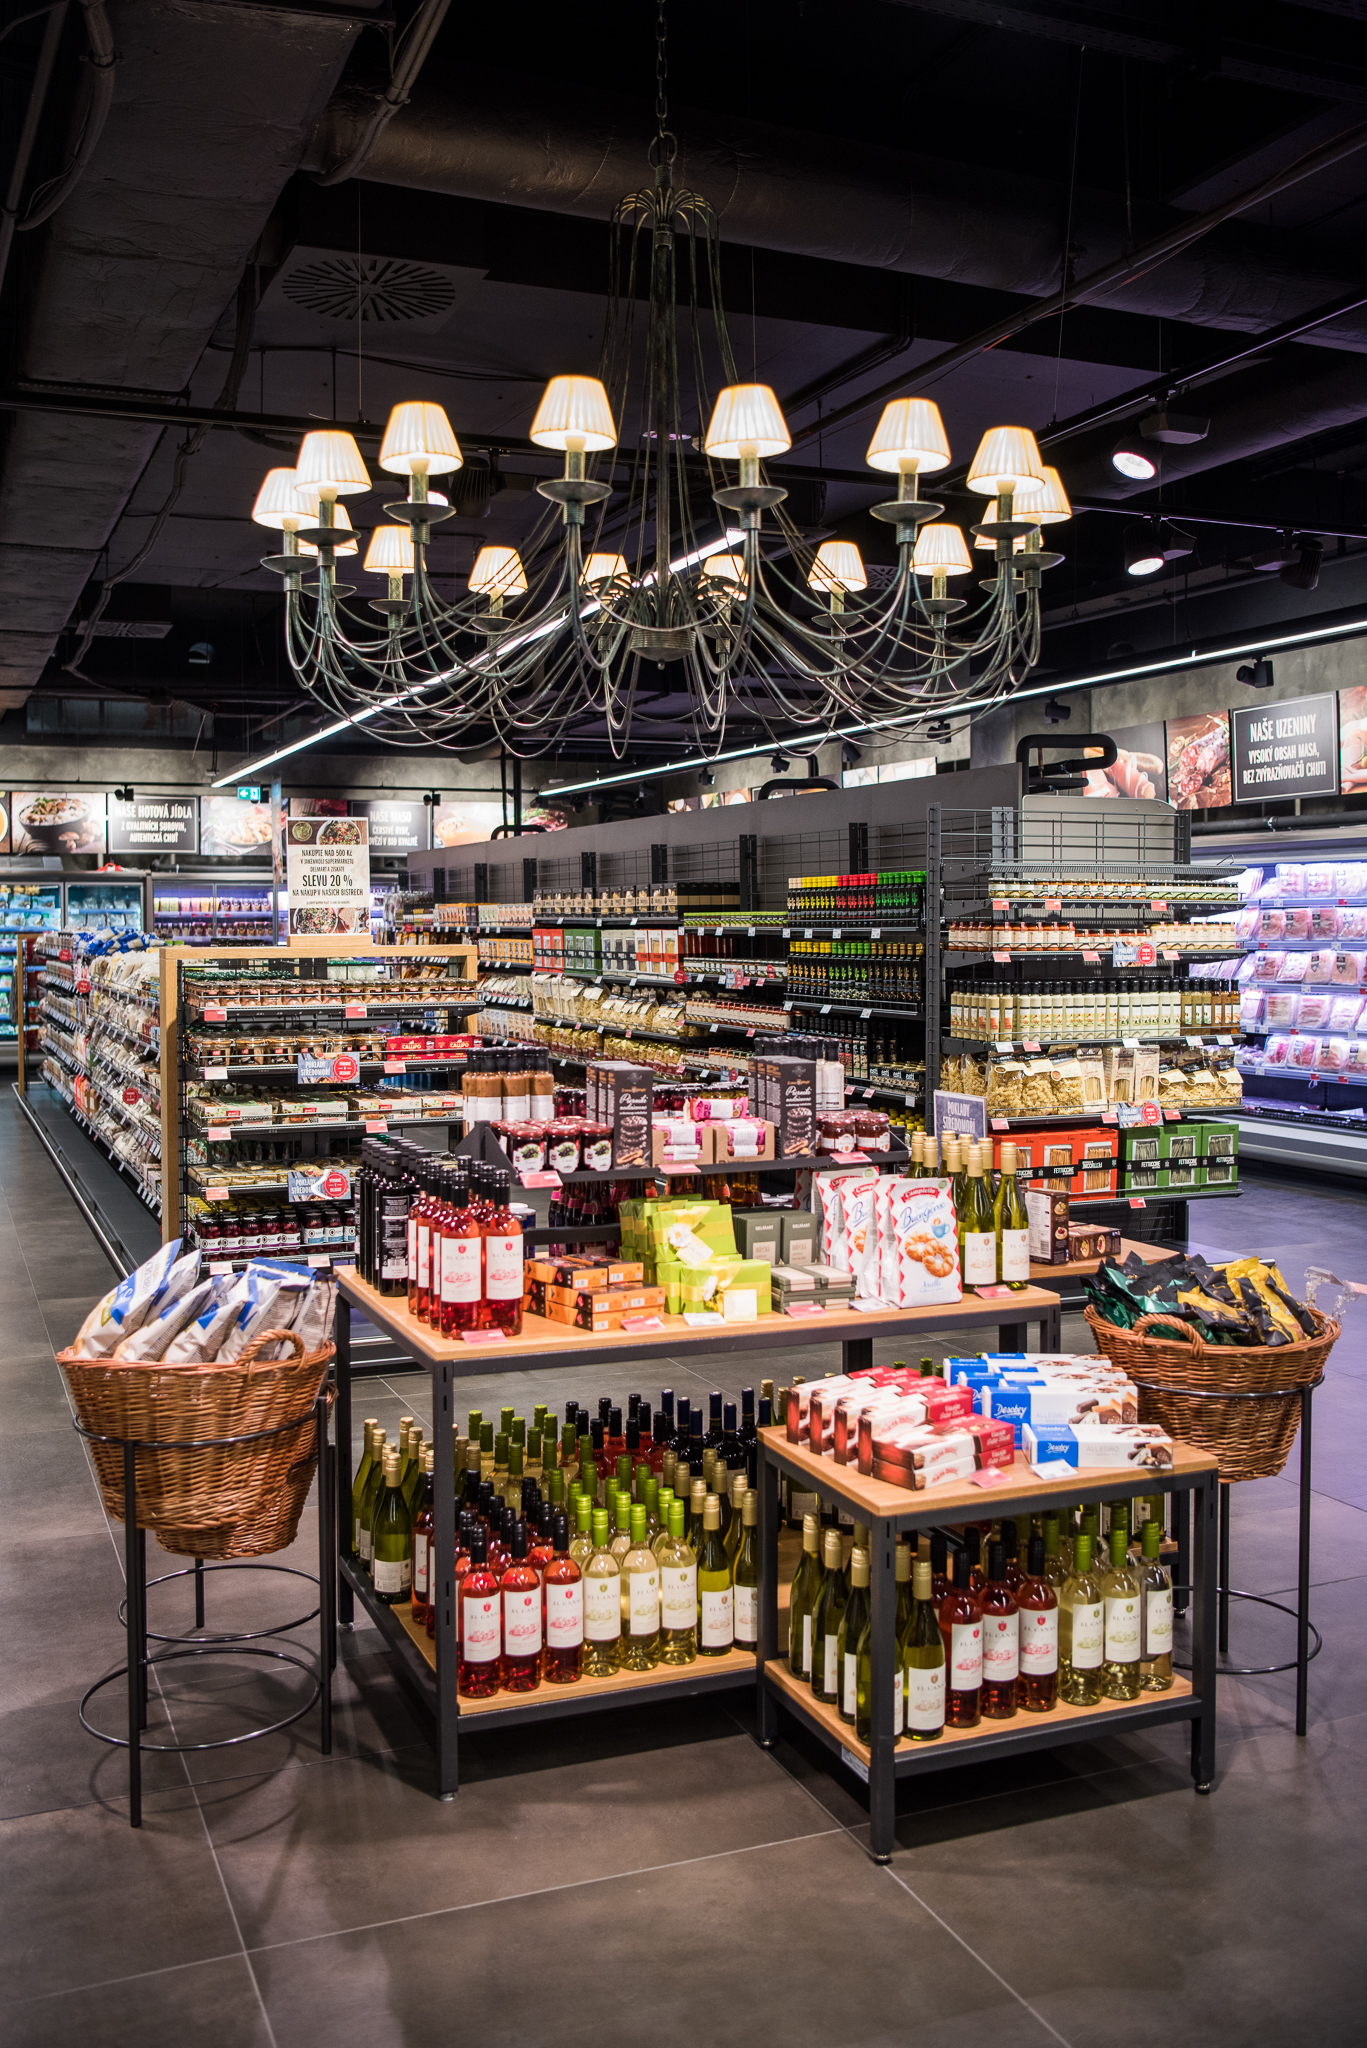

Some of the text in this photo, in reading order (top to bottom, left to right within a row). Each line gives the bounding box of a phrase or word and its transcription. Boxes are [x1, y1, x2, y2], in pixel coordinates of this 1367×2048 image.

[1250, 714, 1316, 742] NAŠE UZENINY
[1248, 742, 1320, 764] VYSOKÝ OBSAH MASA,
[1243, 760, 1326, 784] BEZ ZVÝRAZŇOVAČŮ CHUTI
[115, 803, 192, 818] NAŠE HOTOVÁ JÍDLA
[370, 808, 412, 823] NAŠE MASO
[121, 821, 125, 831] Z
[302, 875, 352, 886] SLEVU 20 %
[341, 888, 363, 896] BISTRECH
[947, 1101, 970, 1117] POKLADY
[943, 1115, 975, 1133] STŘEDOMOŘÍ
[994, 1403, 1027, 1419] Desobry
[1046, 1443, 1069, 1453] Desobry
